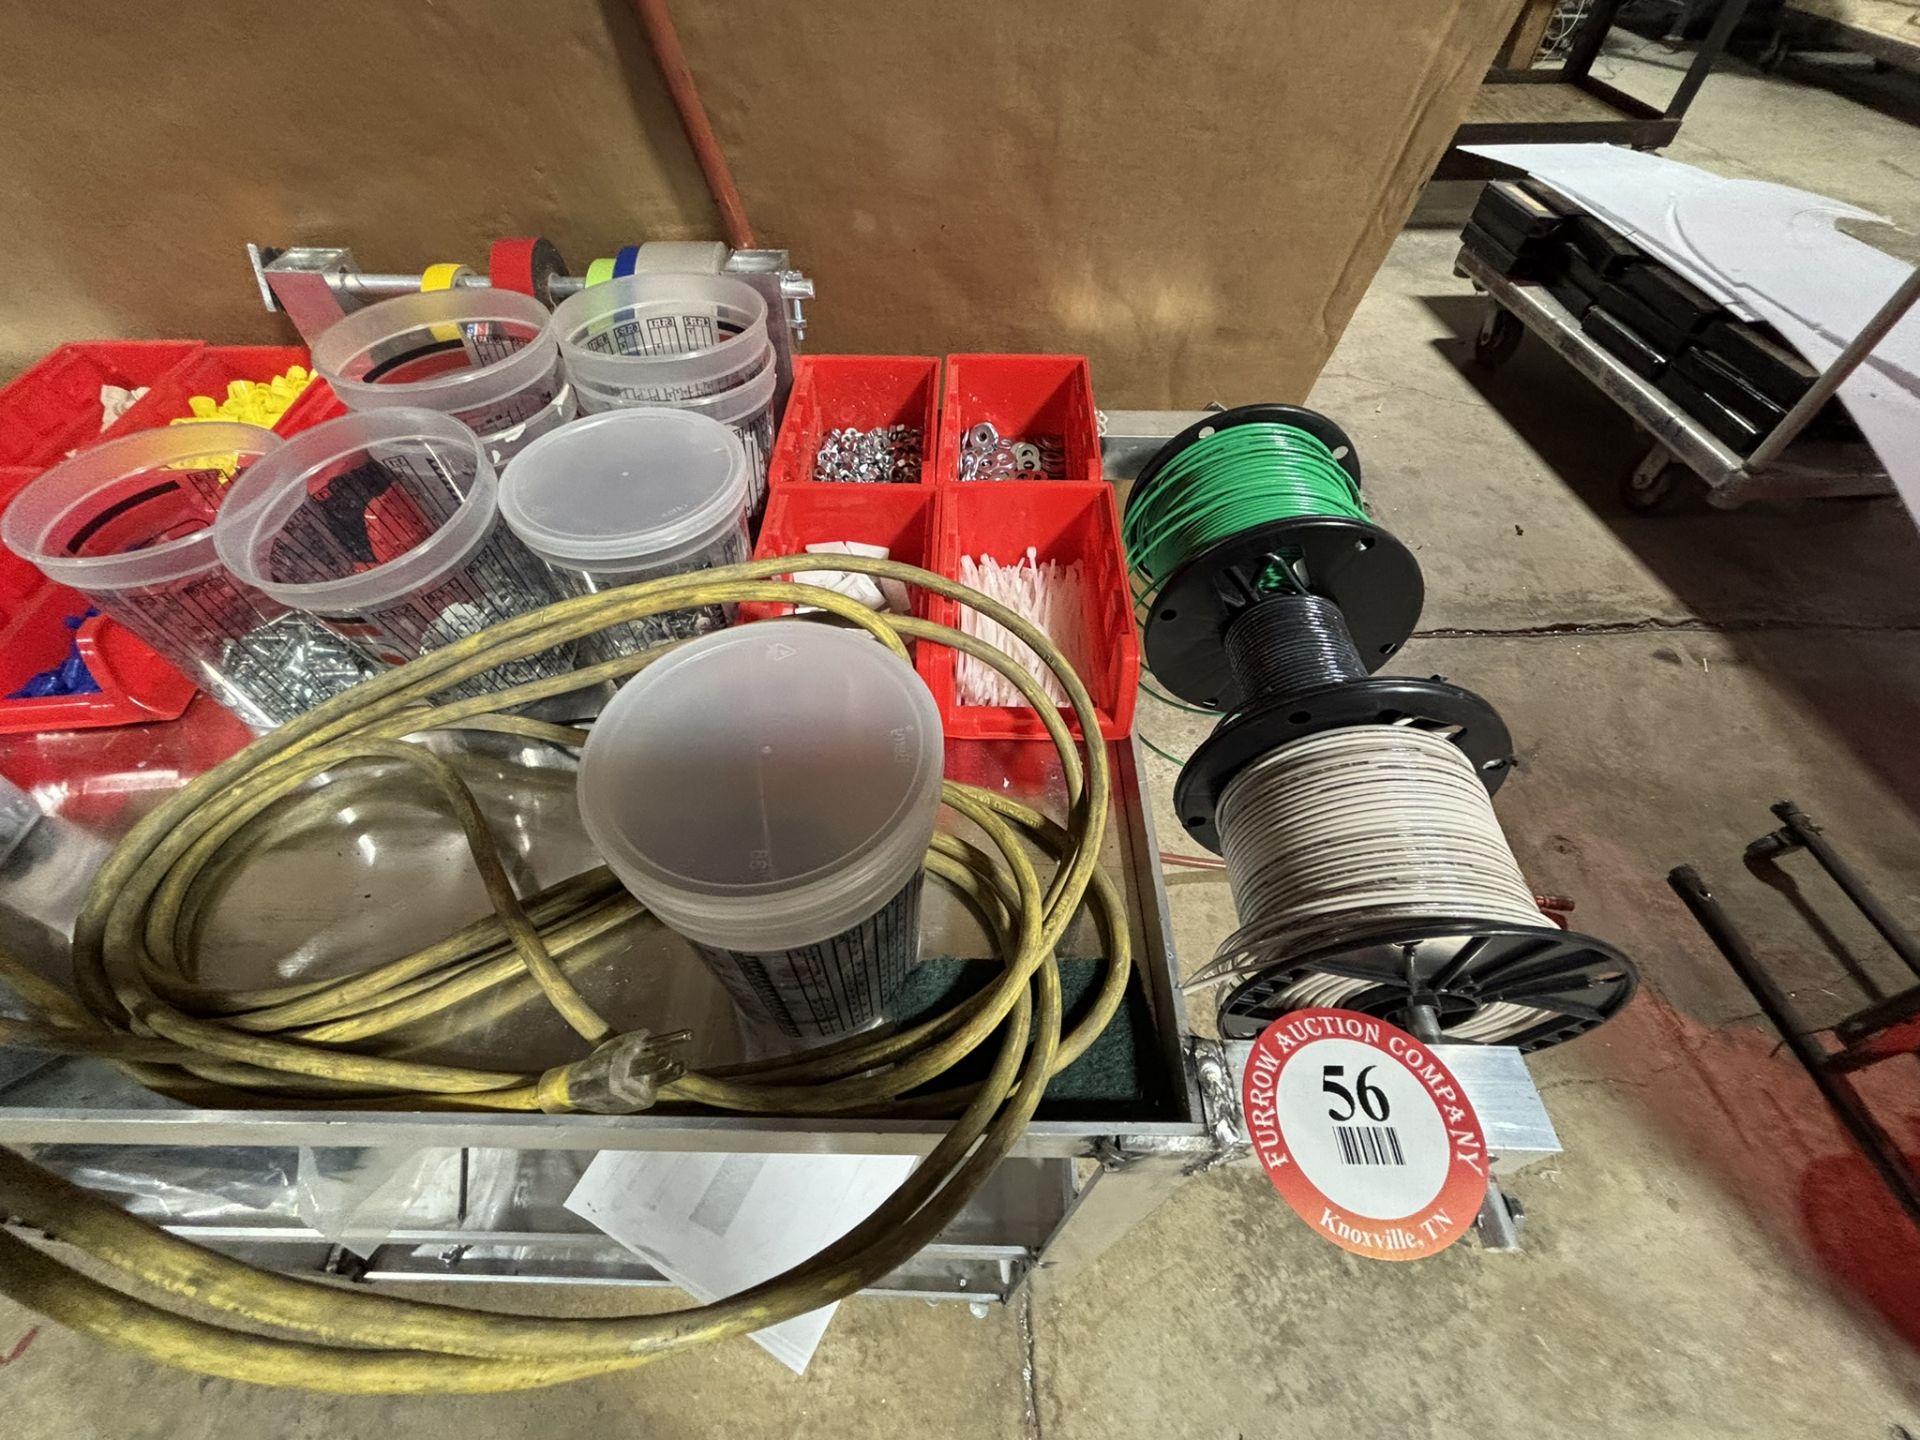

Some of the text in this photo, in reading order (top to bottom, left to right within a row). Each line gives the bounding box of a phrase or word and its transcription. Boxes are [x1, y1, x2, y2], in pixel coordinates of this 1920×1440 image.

[1250, 1016, 1484, 1177] FURROW AUCTION COMPANY
[1322, 1065, 1390, 1122] 56
[1320, 1207, 1453, 1249] Knoxville, TN
